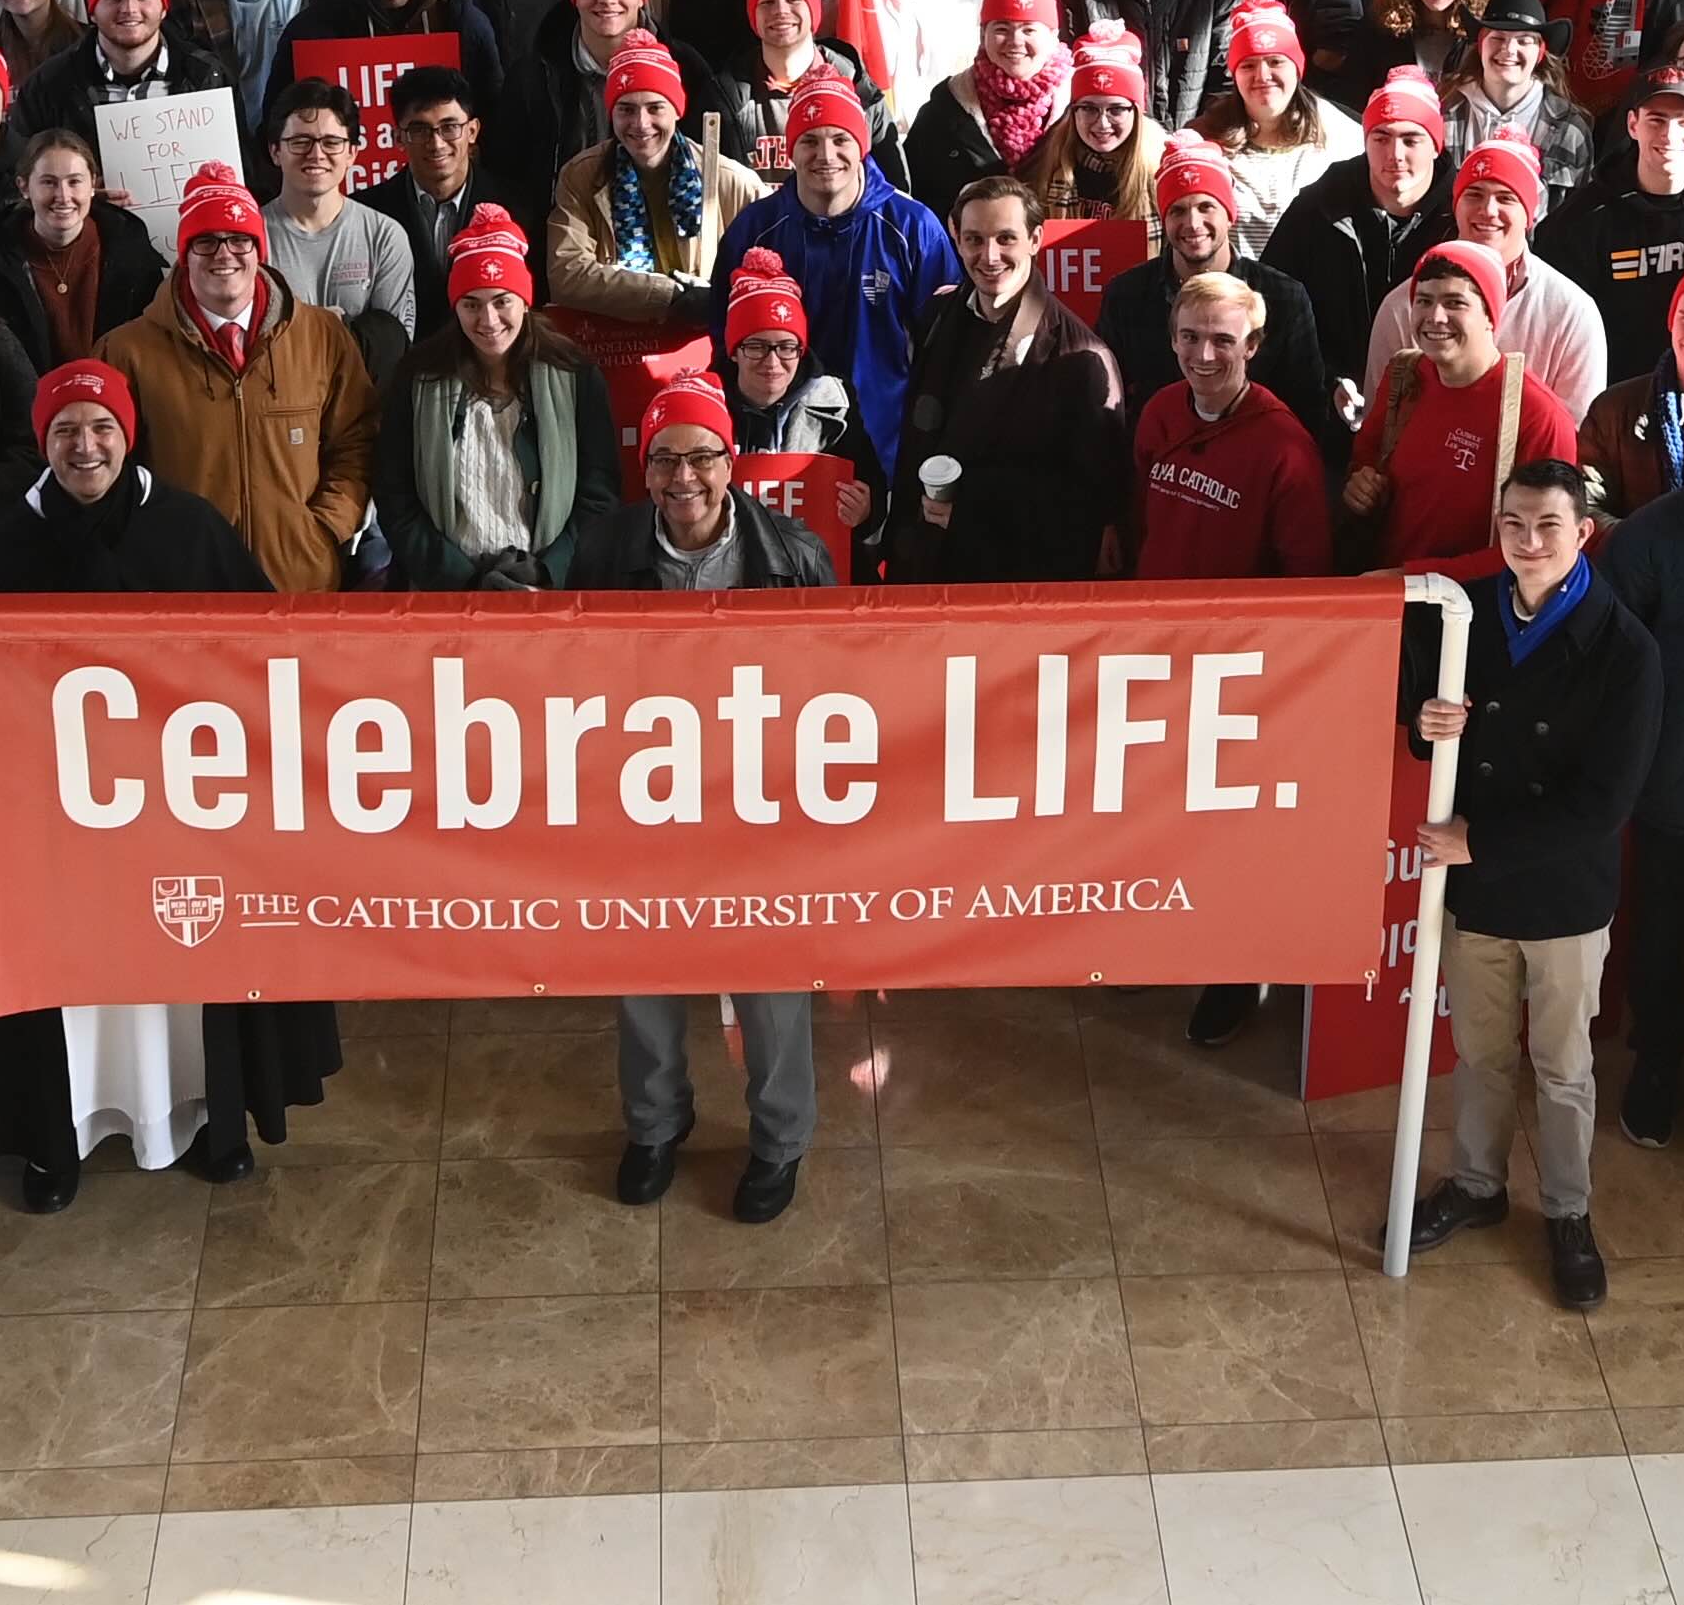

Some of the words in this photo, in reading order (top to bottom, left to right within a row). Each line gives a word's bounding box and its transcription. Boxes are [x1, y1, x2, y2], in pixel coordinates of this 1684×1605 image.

[110, 115, 142, 141] WE
[156, 105, 215, 134] STAND
[377, 123, 393, 149] a
[147, 140, 185, 161] FOR
[1046, 248, 1103, 292] IFE
[1179, 466, 1241, 509] CATHOLIC
[51, 655, 880, 833] Celebrate
[942, 650, 1300, 822] LIFE.
[234, 892, 300, 914] THE
[306, 893, 560, 930] CATHOLIC
[578, 891, 875, 930] UNIVERSITY
[888, 887, 953, 923] OF
[964, 877, 1196, 918] AMERICA
